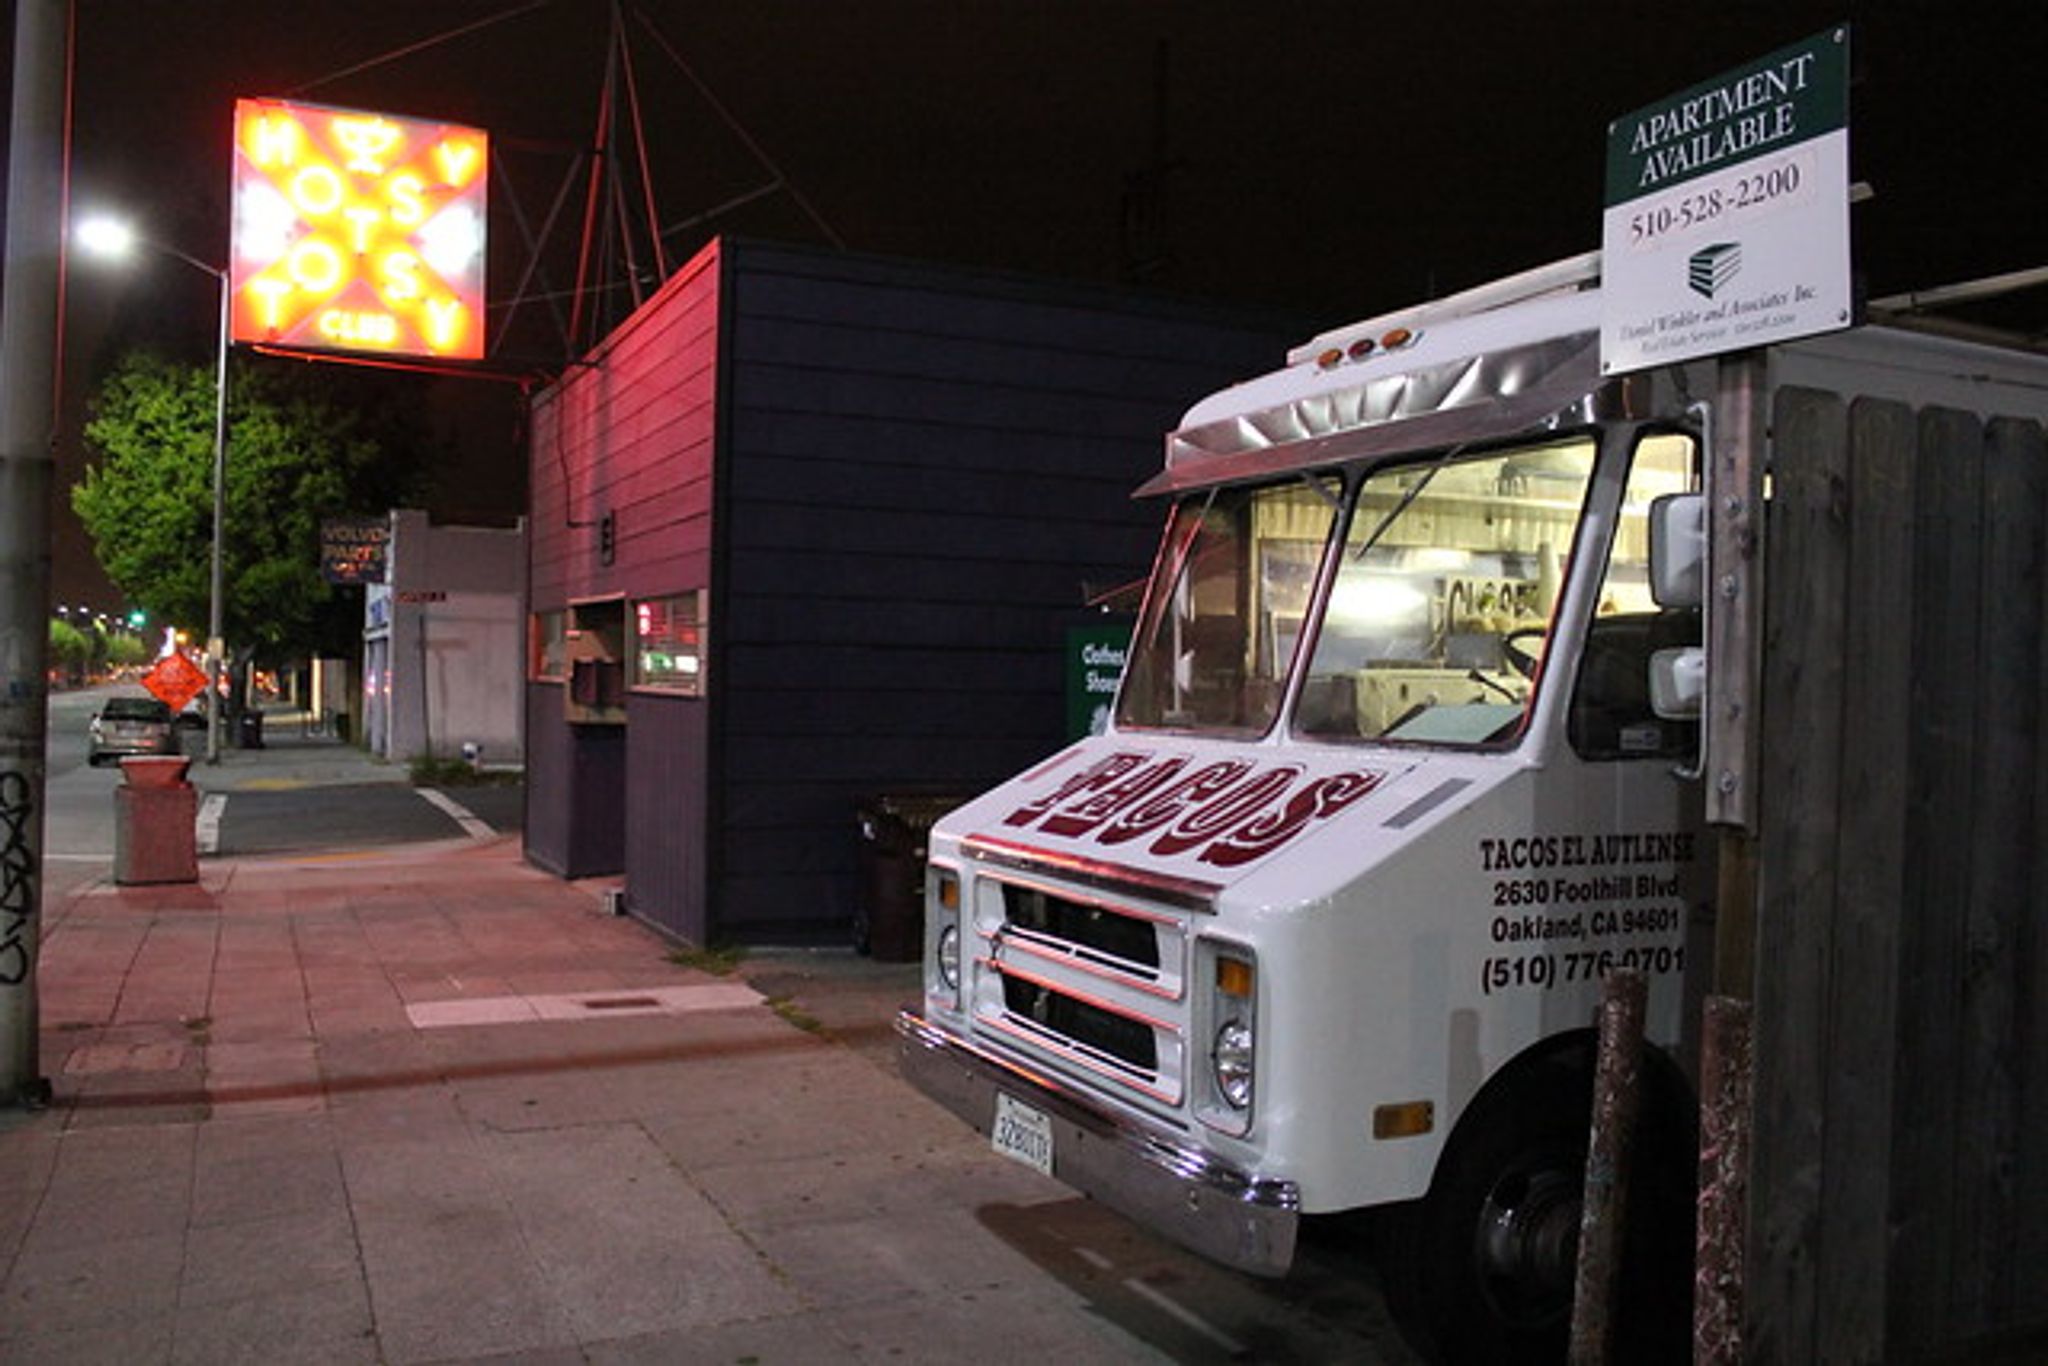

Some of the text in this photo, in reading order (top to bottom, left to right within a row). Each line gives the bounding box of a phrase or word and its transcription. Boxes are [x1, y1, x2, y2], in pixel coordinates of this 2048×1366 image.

[1630, 53, 1815, 153] APARTMENT
[1639, 102, 1795, 186] AVAILABLE
[1631, 162, 1800, 242] 510-528-2200
[1003, 752, 1388, 867] TACOS
[1481, 836, 1558, 871] TACOS
[1561, 836, 1586, 866] EL
[1494, 874, 1678, 906] 2630 Foothill Blvd
[1491, 912, 1587, 942] Oakland,
[1591, 911, 1618, 935] CA
[1482, 954, 1556, 995] (510)
